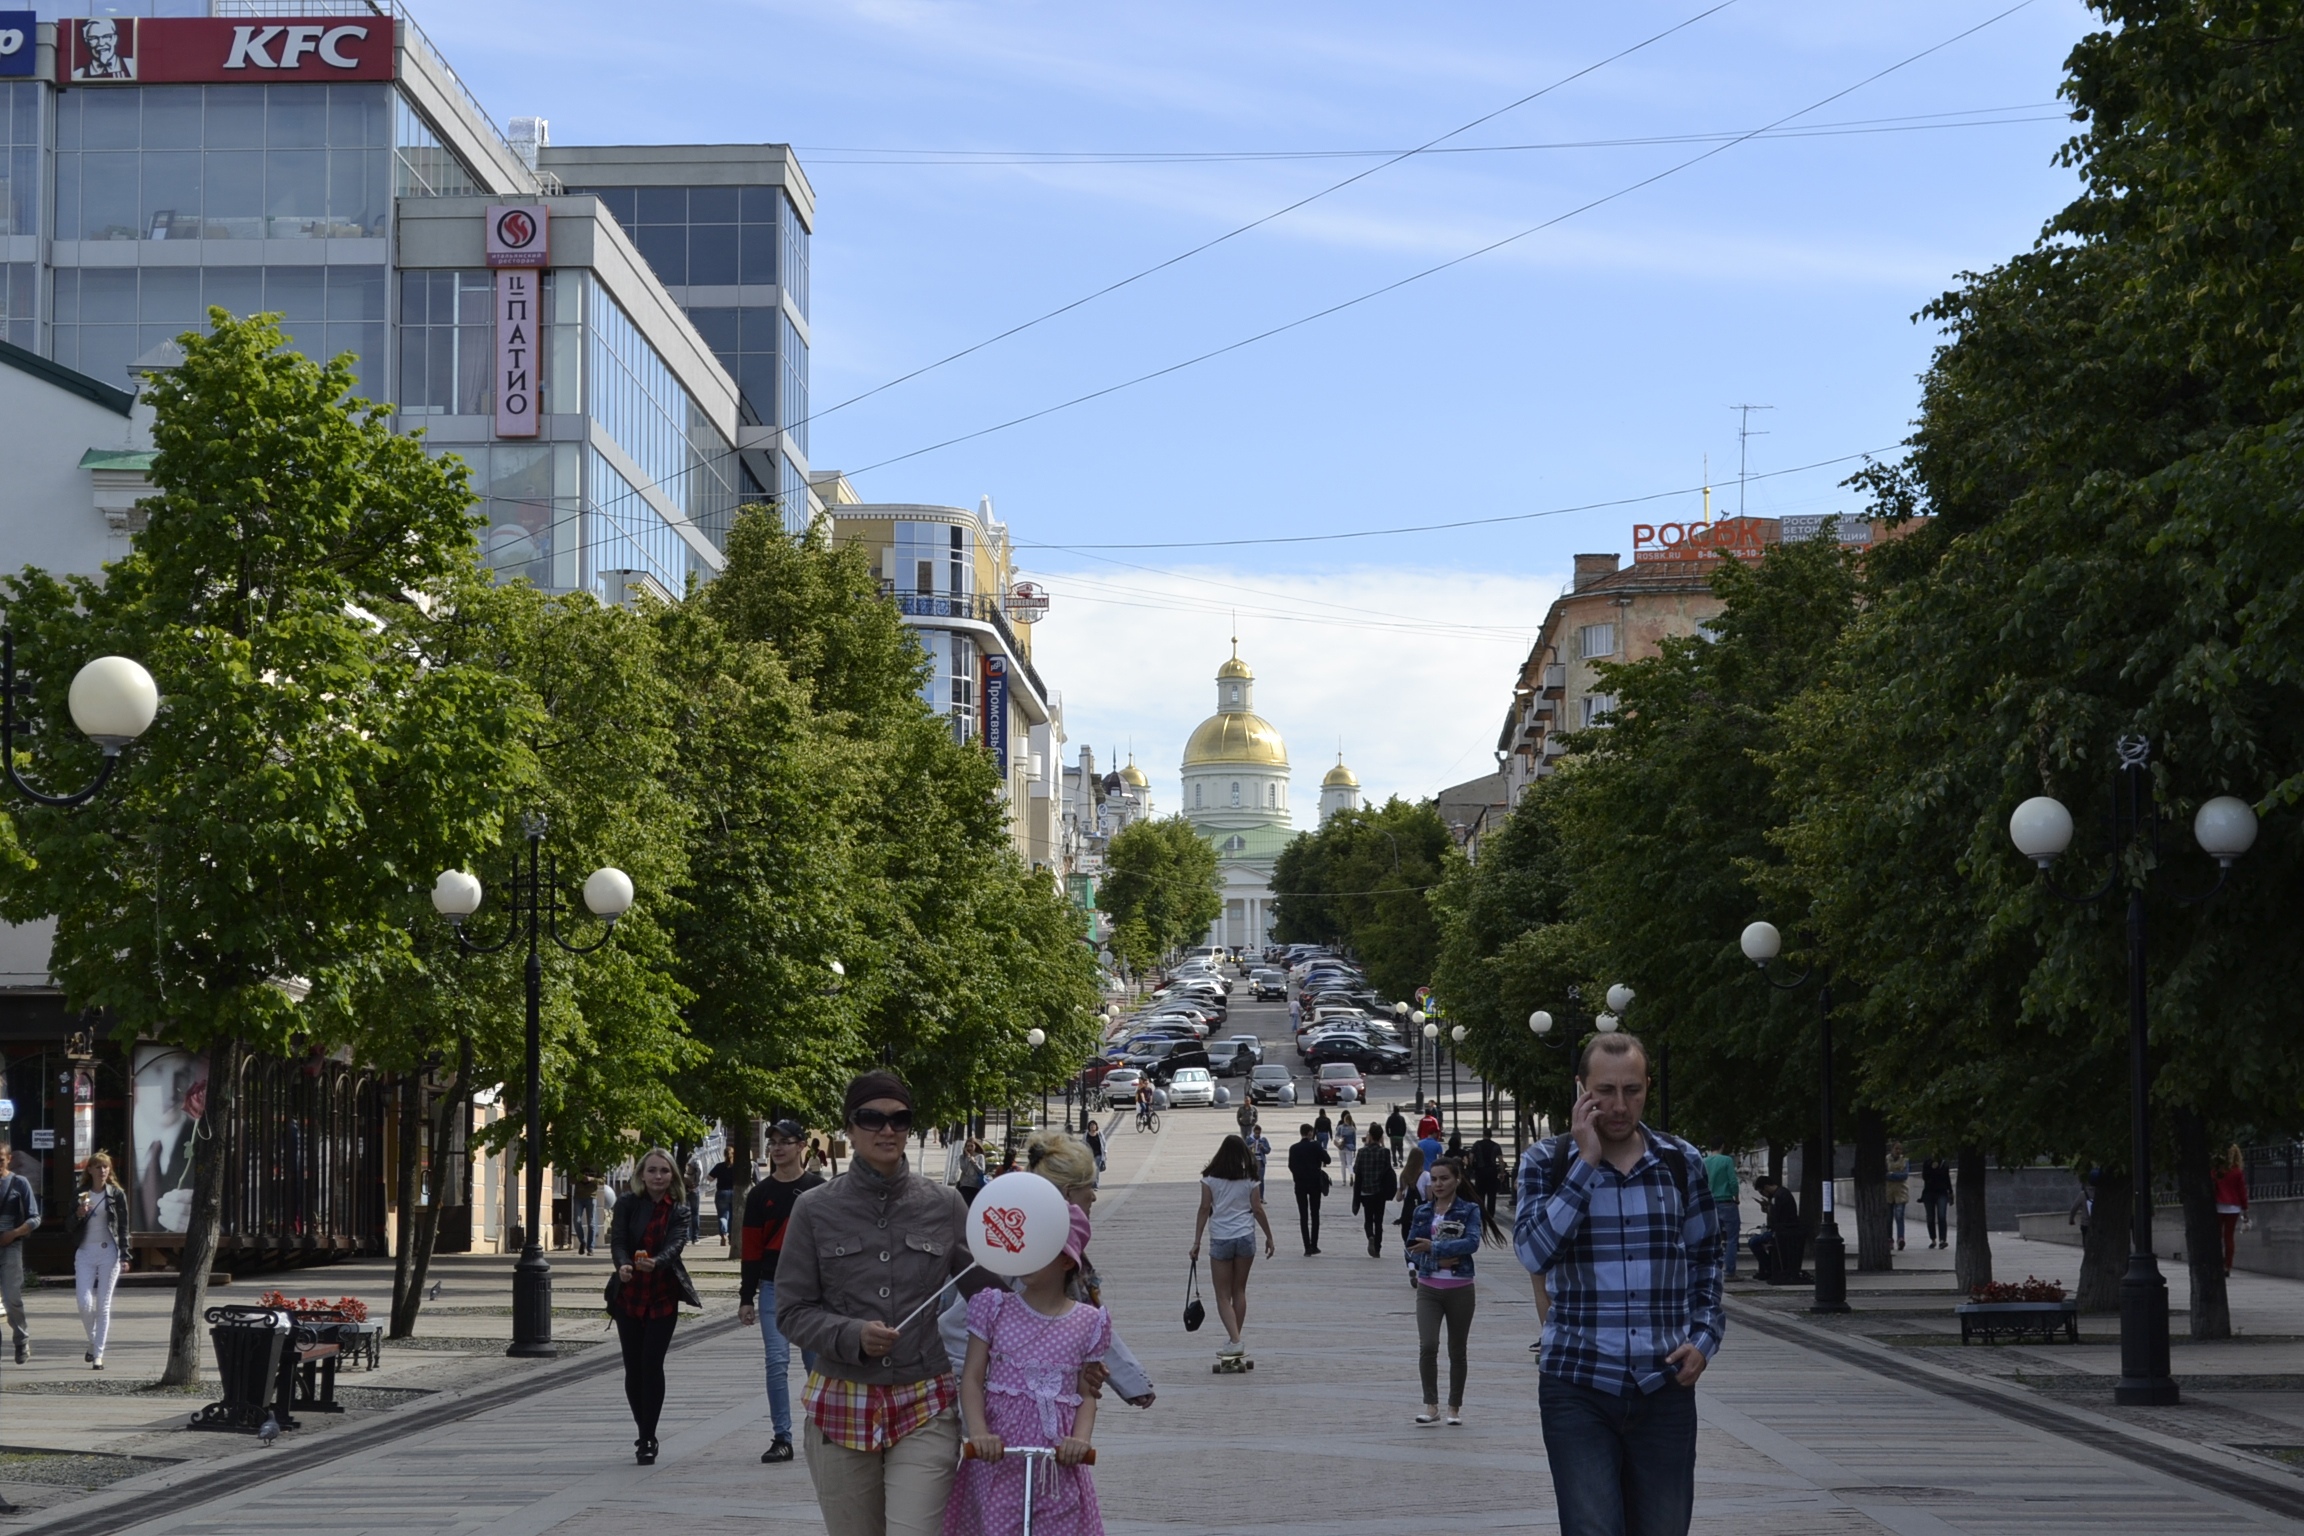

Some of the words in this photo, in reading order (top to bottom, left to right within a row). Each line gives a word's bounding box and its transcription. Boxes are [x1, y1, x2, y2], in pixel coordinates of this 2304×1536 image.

[223, 25, 369, 69] KFC
[506, 300, 527, 415] ПАТИО
[1783, 515, 1859, 525] РОССИКИ
[1783, 525, 1845, 534] БЕТОНЕ
[1633, 519, 1764, 550] РОСБК
[1783, 533, 1867, 543] КОНКЦИИ
[1636, 551, 1681, 561] ROSBK.RU
[1005, 598, 1048, 607] BASKERVILLE
[987, 680, 1003, 766] Промсвязьб
[985, 1210, 1022, 1250] БОЛЬШОЙ
